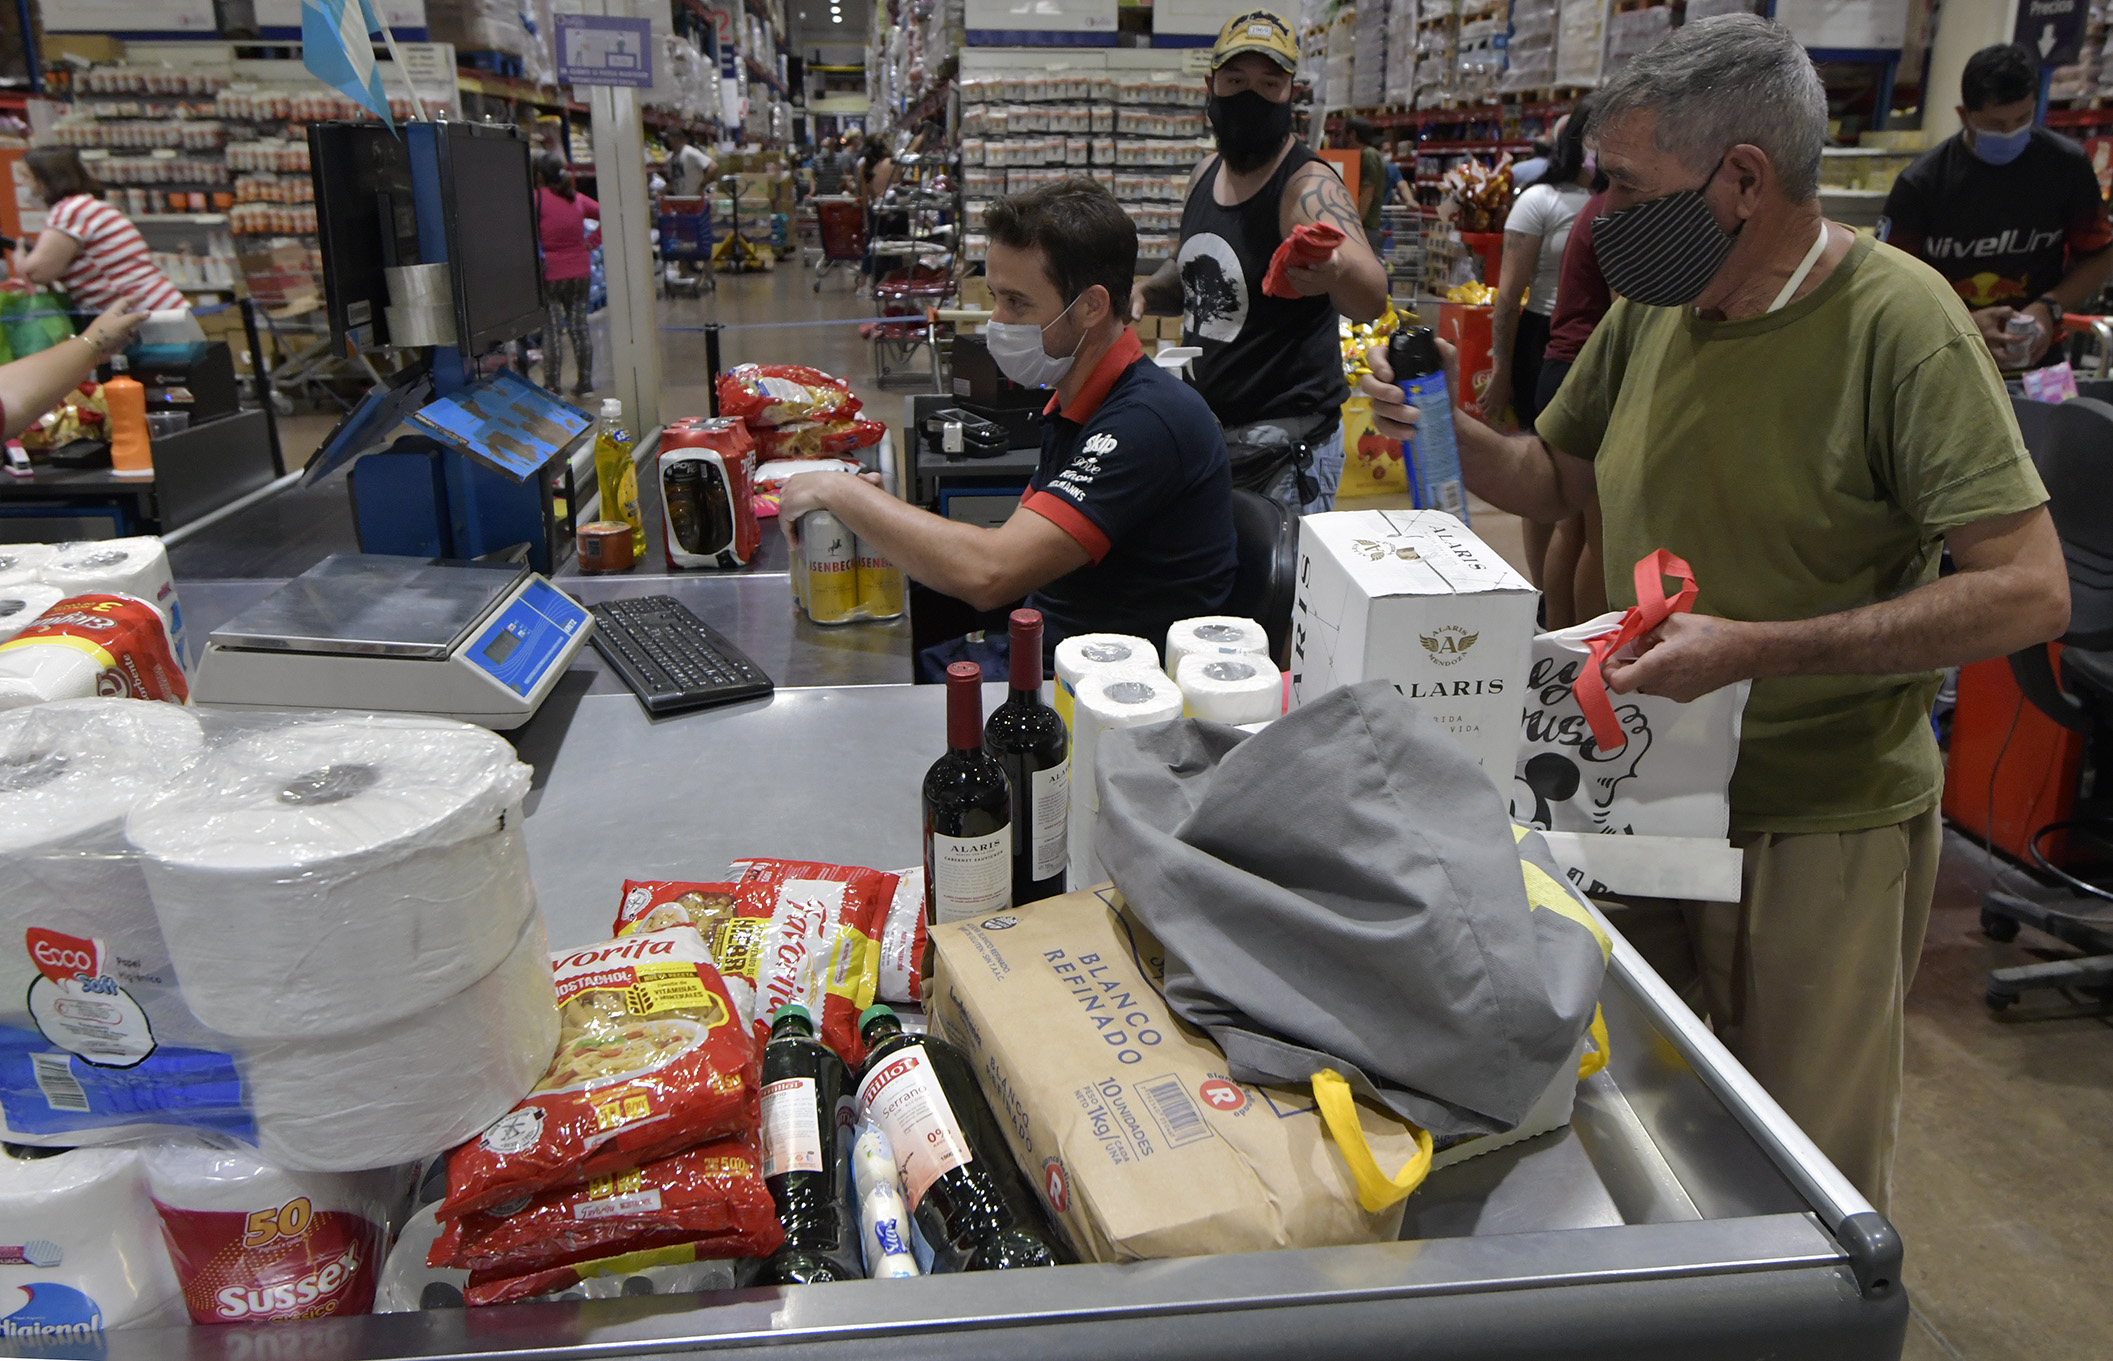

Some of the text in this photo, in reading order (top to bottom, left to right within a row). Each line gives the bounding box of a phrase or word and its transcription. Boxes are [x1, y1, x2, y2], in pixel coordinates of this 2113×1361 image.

[1429, 525, 1487, 570] ALARIS
[1432, 625, 1468, 637] ALARIS
[1438, 636, 1458, 654] A
[1428, 651, 1468, 667] MENDOZA
[951, 839, 1001, 853] ALARIS
[1043, 947, 1142, 1064] REFINADO
[1078, 952, 1162, 1046] BLANCO
[882, 1085, 927, 1120] Serrano
[989, 1056, 1030, 1129] BLANCO
[1074, 1090, 1090, 1109] NETO
[1083, 1085, 1099, 1106] PESO
[1206, 1087, 1236, 1106] R
[1098, 1076, 1154, 1157] 10 UNIDADES
[1105, 1143, 1123, 1166] UNA
[1114, 1138, 1131, 1163] CADA
[1050, 1171, 1063, 1208] R
[243, 1196, 312, 1248] 50
[217, 1240, 361, 1318] Sussex
